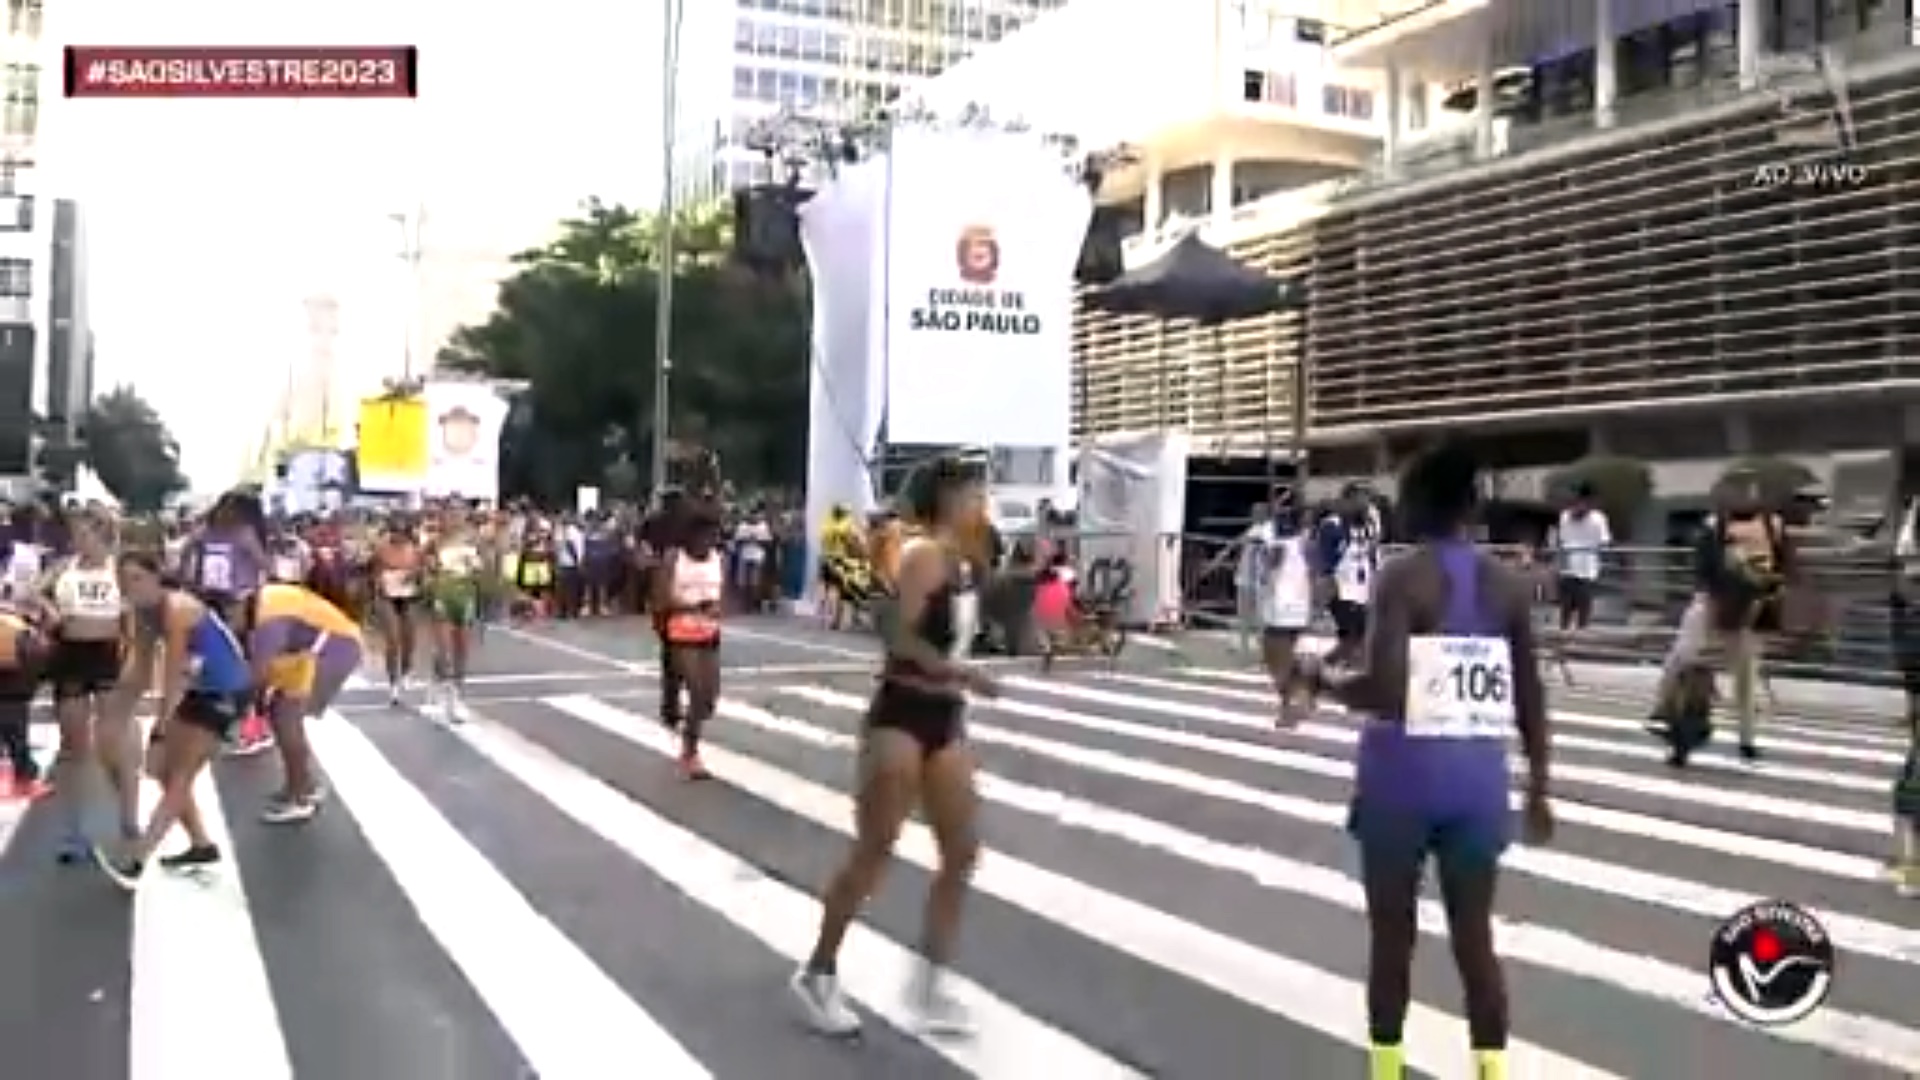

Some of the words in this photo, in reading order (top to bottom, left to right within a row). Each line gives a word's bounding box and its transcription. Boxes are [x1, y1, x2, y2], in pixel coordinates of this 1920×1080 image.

[929, 288, 996, 307] CIDADE
[966, 311, 1041, 335] PAULO
[1450, 662, 1509, 703] 106
